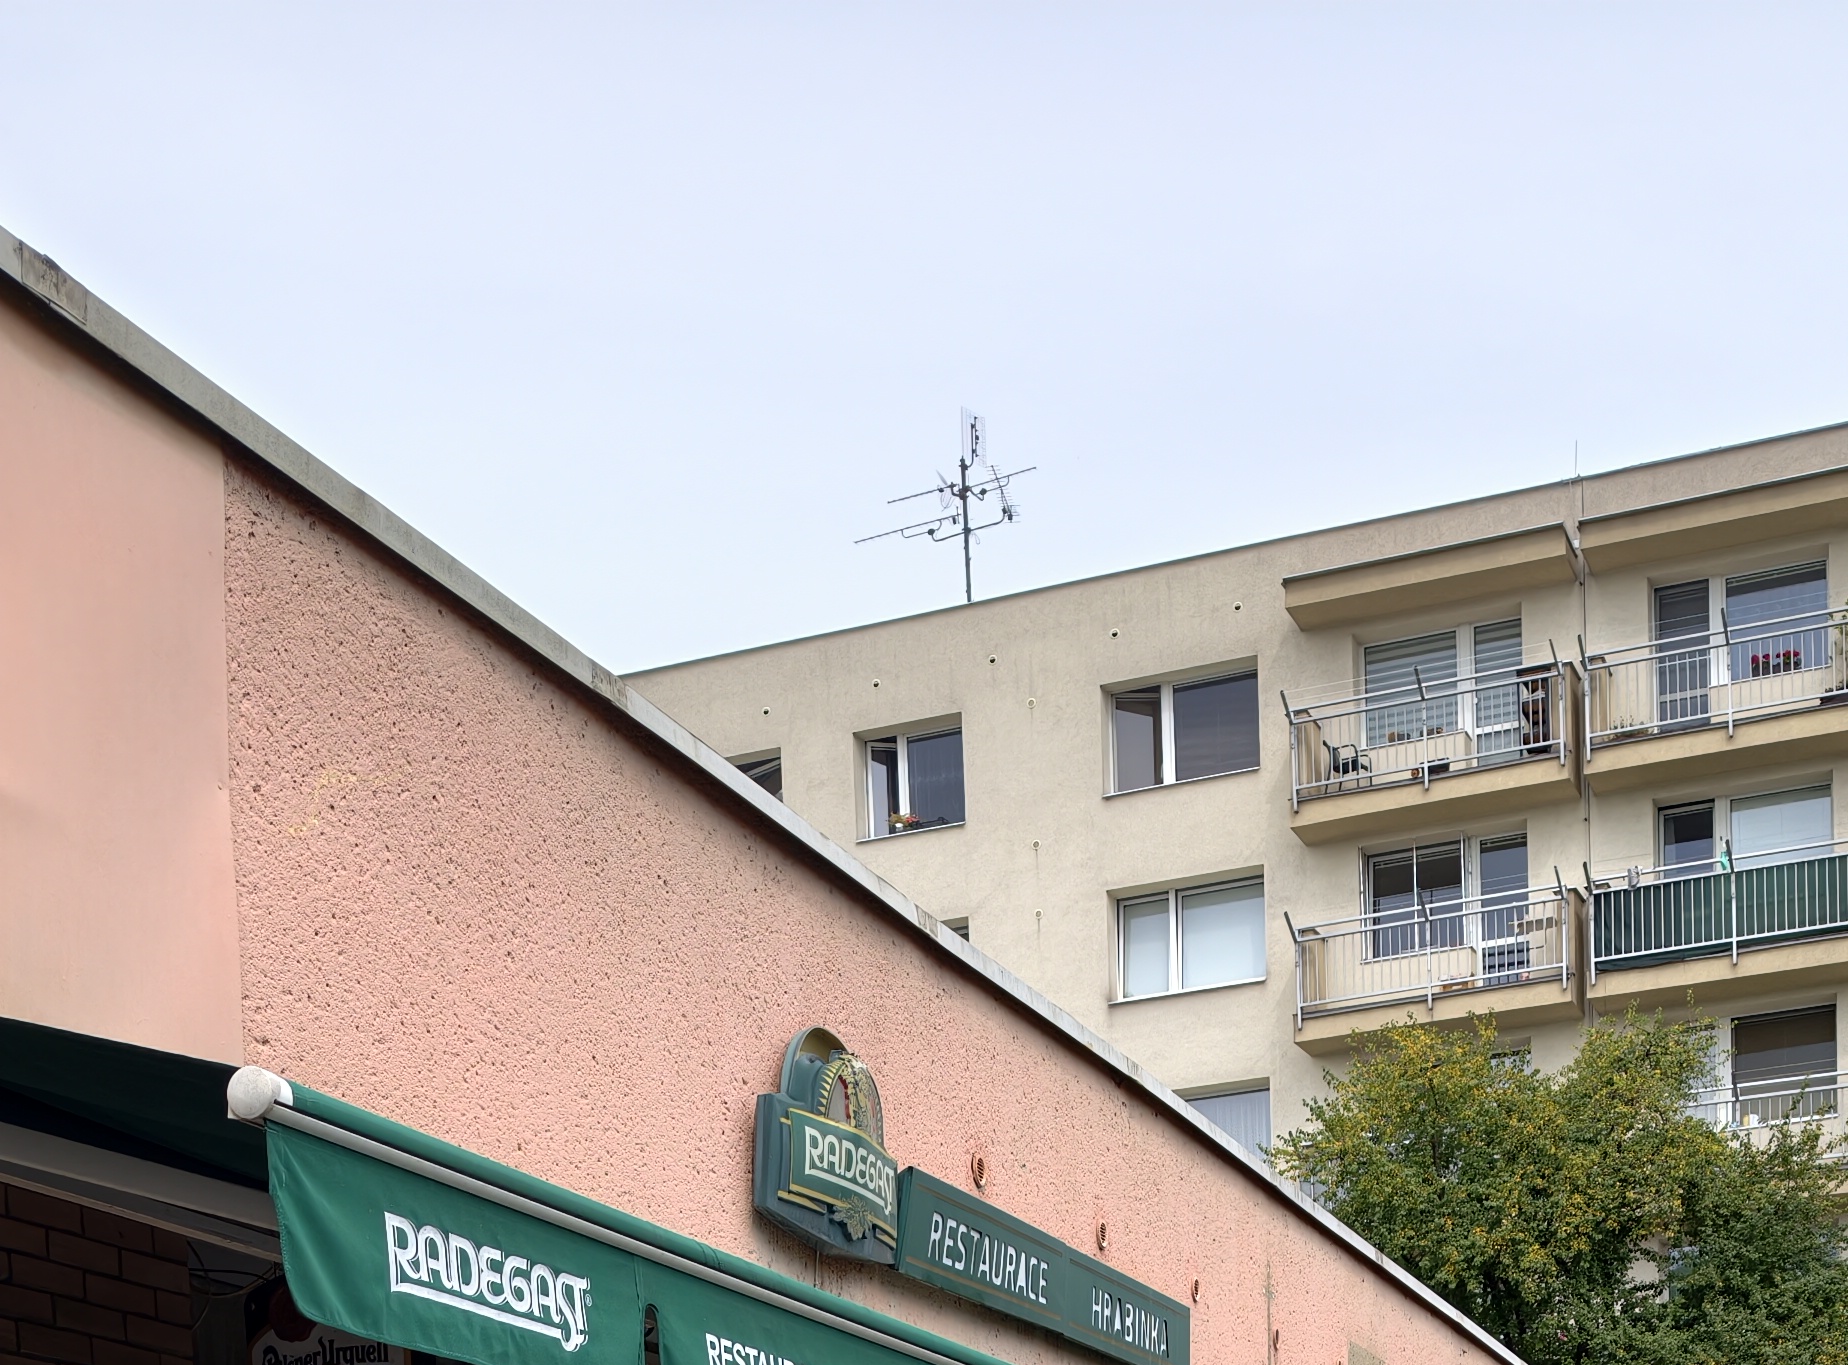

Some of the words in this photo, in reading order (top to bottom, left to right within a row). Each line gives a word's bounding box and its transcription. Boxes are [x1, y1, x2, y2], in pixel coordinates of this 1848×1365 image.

[805, 1125, 895, 1215] RADEGAST
[384, 1211, 592, 1352] RADEGAST
[928, 1211, 1048, 1305] RESTAURACE
[1091, 1285, 1169, 1358] HRABINKA
